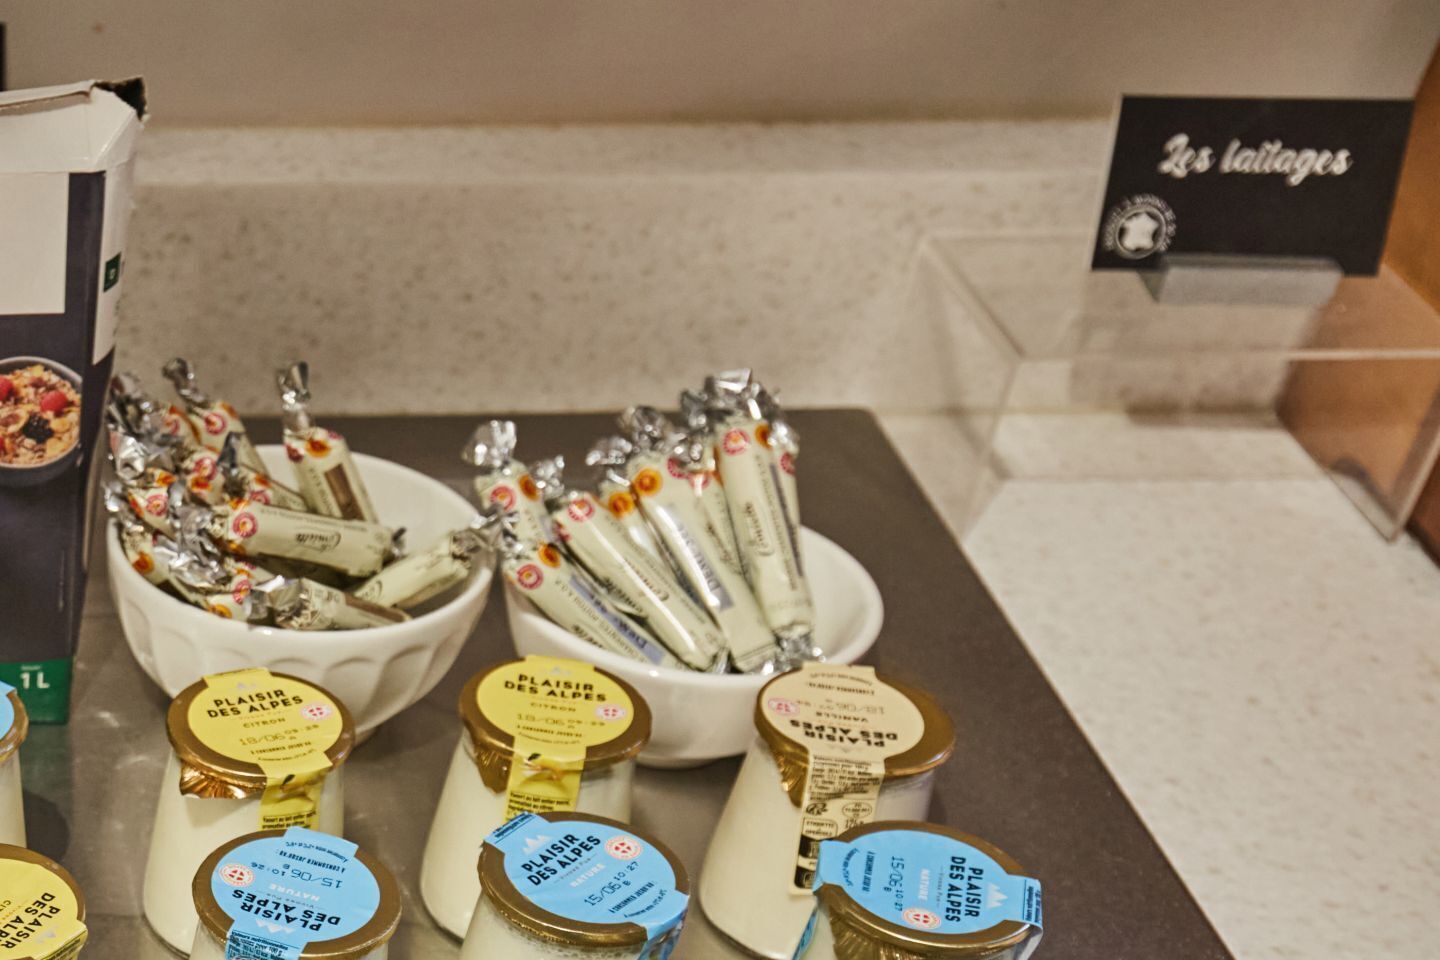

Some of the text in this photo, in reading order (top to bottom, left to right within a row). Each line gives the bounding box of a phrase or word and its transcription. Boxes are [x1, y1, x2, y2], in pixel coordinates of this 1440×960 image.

[1158, 133, 1354, 187] Les laitages
[20, 671, 31, 690] 1
[36, 671, 51, 689] L
[504, 680, 606, 702] DES ALPES
[518, 674, 594, 692] PLAISIR
[207, 696, 303, 718] DES ALPES
[213, 689, 285, 708] PLAISIR
[243, 717, 286, 728] CITRON
[790, 719, 898, 740] DES ALPES
[804, 730, 885, 747] PLAISIR
[521, 834, 580, 872] PLAISIR
[527, 835, 601, 886] DES ALPES
[307, 859, 340, 871] CONSOMMER
[570, 863, 606, 887] NATURE
[888, 856, 904, 887] 15/06
[291, 869, 343, 889] 15/06
[918, 869, 930, 900] NATURE
[945, 856, 966, 922] DES ALPES
[269, 883, 320, 902] NATURE
[584, 876, 622, 906] 15/06
[964, 867, 984, 917] PLAISIR
[24, 892, 56, 915] DES
[232, 889, 341, 925] DES ALPES
[0, 906, 61, 949] PLAISIR
[240, 902, 322, 931] PLAISIR
